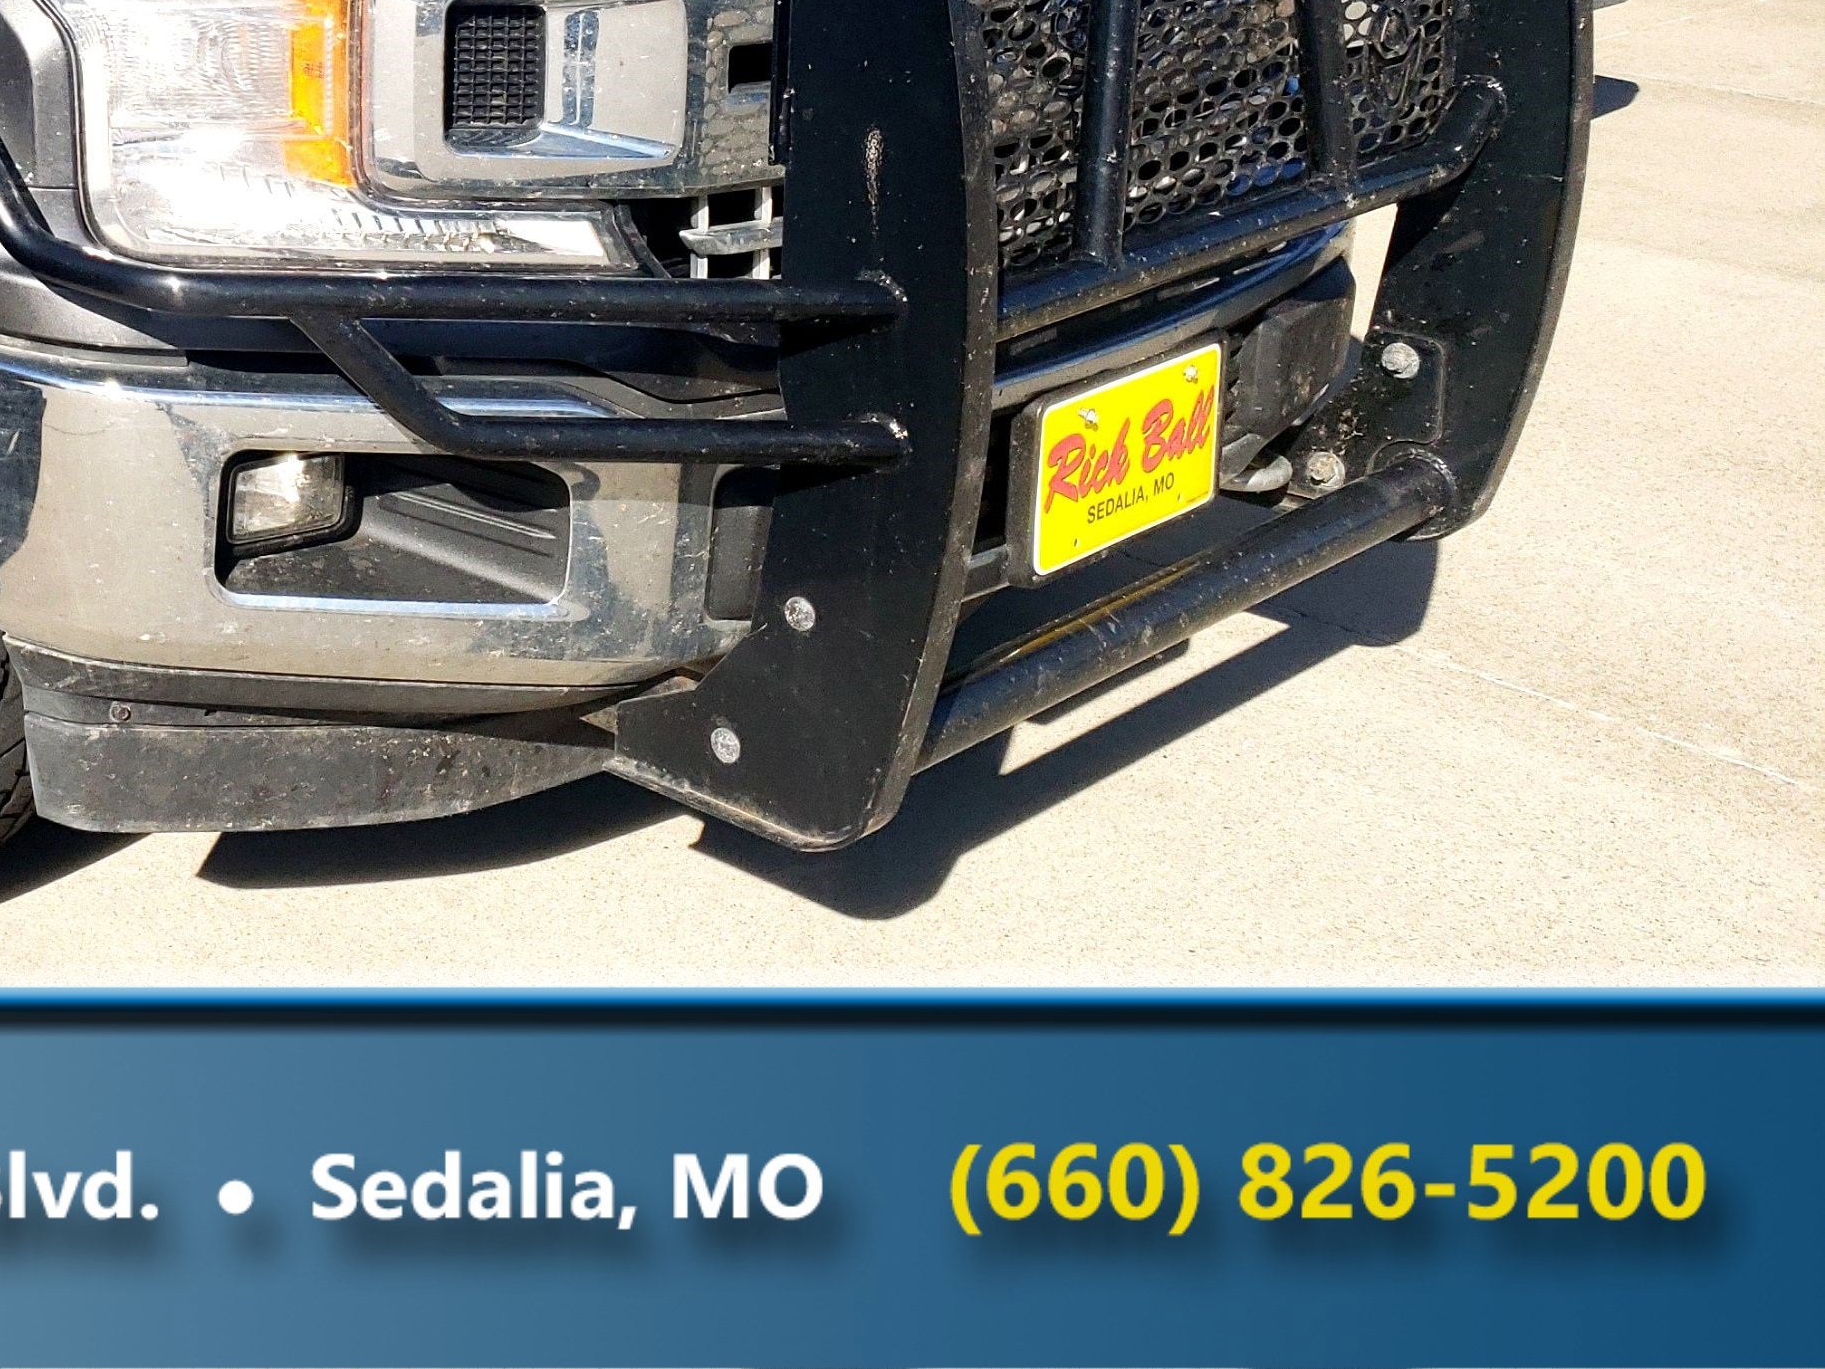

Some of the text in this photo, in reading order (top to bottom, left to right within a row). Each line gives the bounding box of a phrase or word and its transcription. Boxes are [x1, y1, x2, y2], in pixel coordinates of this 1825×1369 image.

[1044, 385, 1215, 513] Rick Ball
[1086, 472, 1175, 524] SEDALIA, MO
